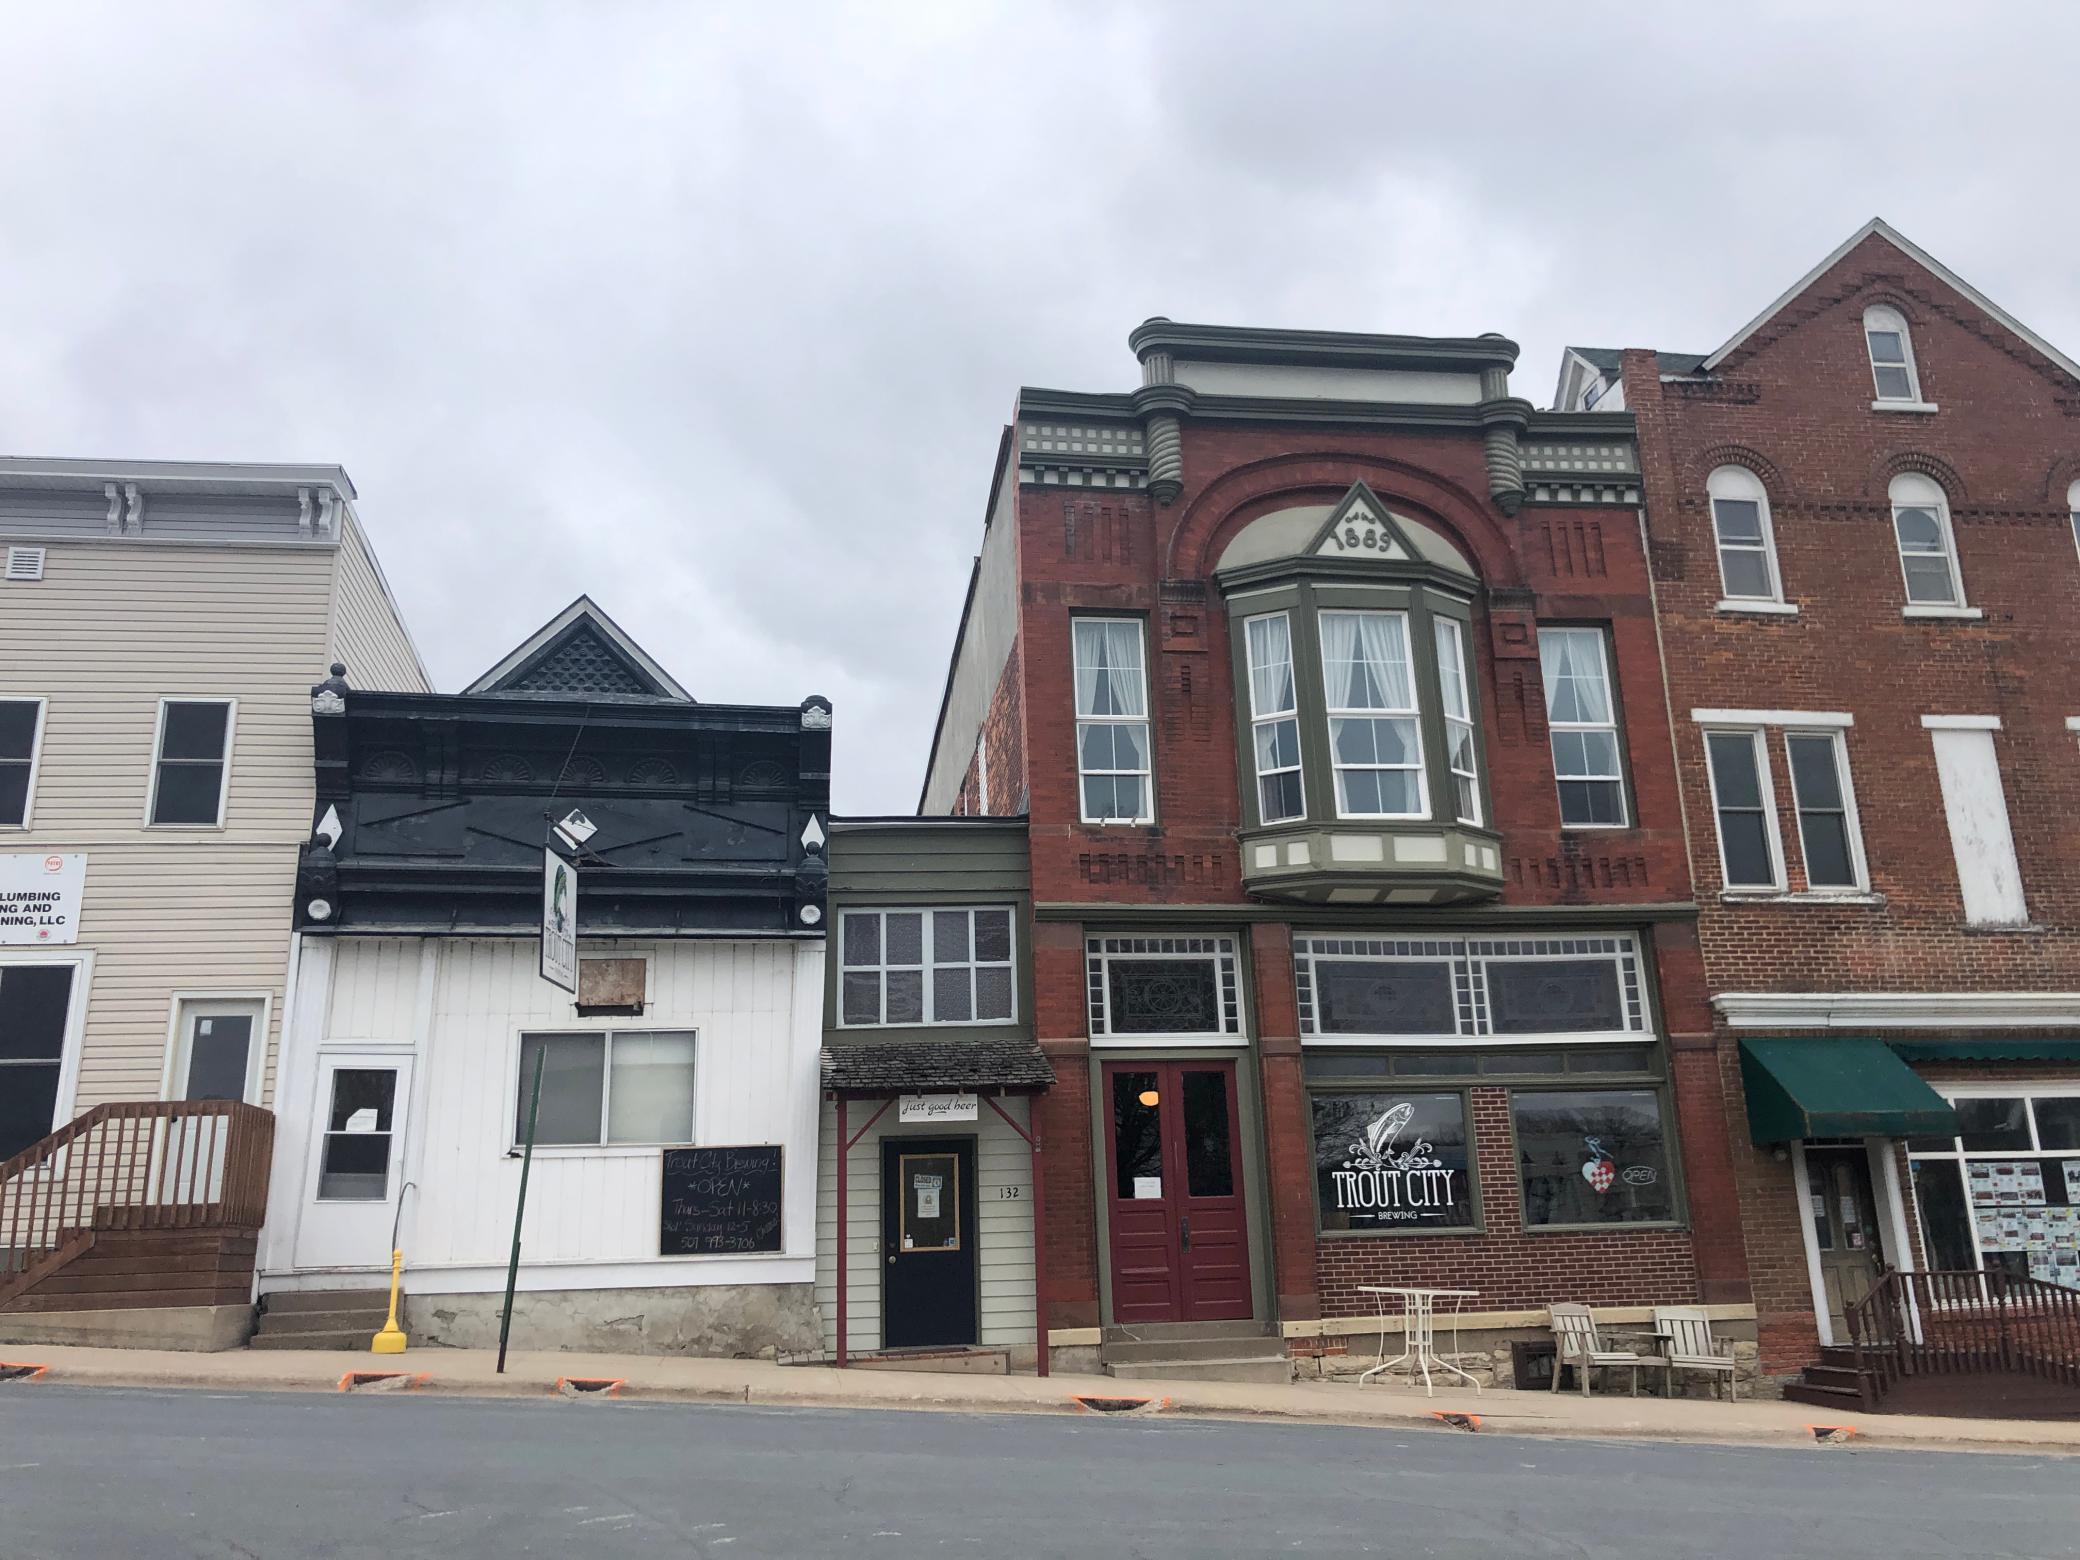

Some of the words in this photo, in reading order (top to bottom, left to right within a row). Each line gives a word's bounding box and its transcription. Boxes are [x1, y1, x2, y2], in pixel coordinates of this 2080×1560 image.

[1330, 527, 1391, 552] 1889
[23, 904, 52, 913] AND
[39, 916, 66, 925] LLC
[928, 1099, 952, 1116] good
[954, 1099, 976, 1110] beer
[665, 1150, 698, 1169] Trout
[700, 1151, 721, 1176] City
[1623, 1170, 1657, 1180] OPEN
[1000, 1187, 1019, 1199] 132
[1332, 1170, 1401, 1208] TROUT
[1405, 1169, 1454, 1206] CITY
[1378, 1211, 1417, 1220] BREWING
